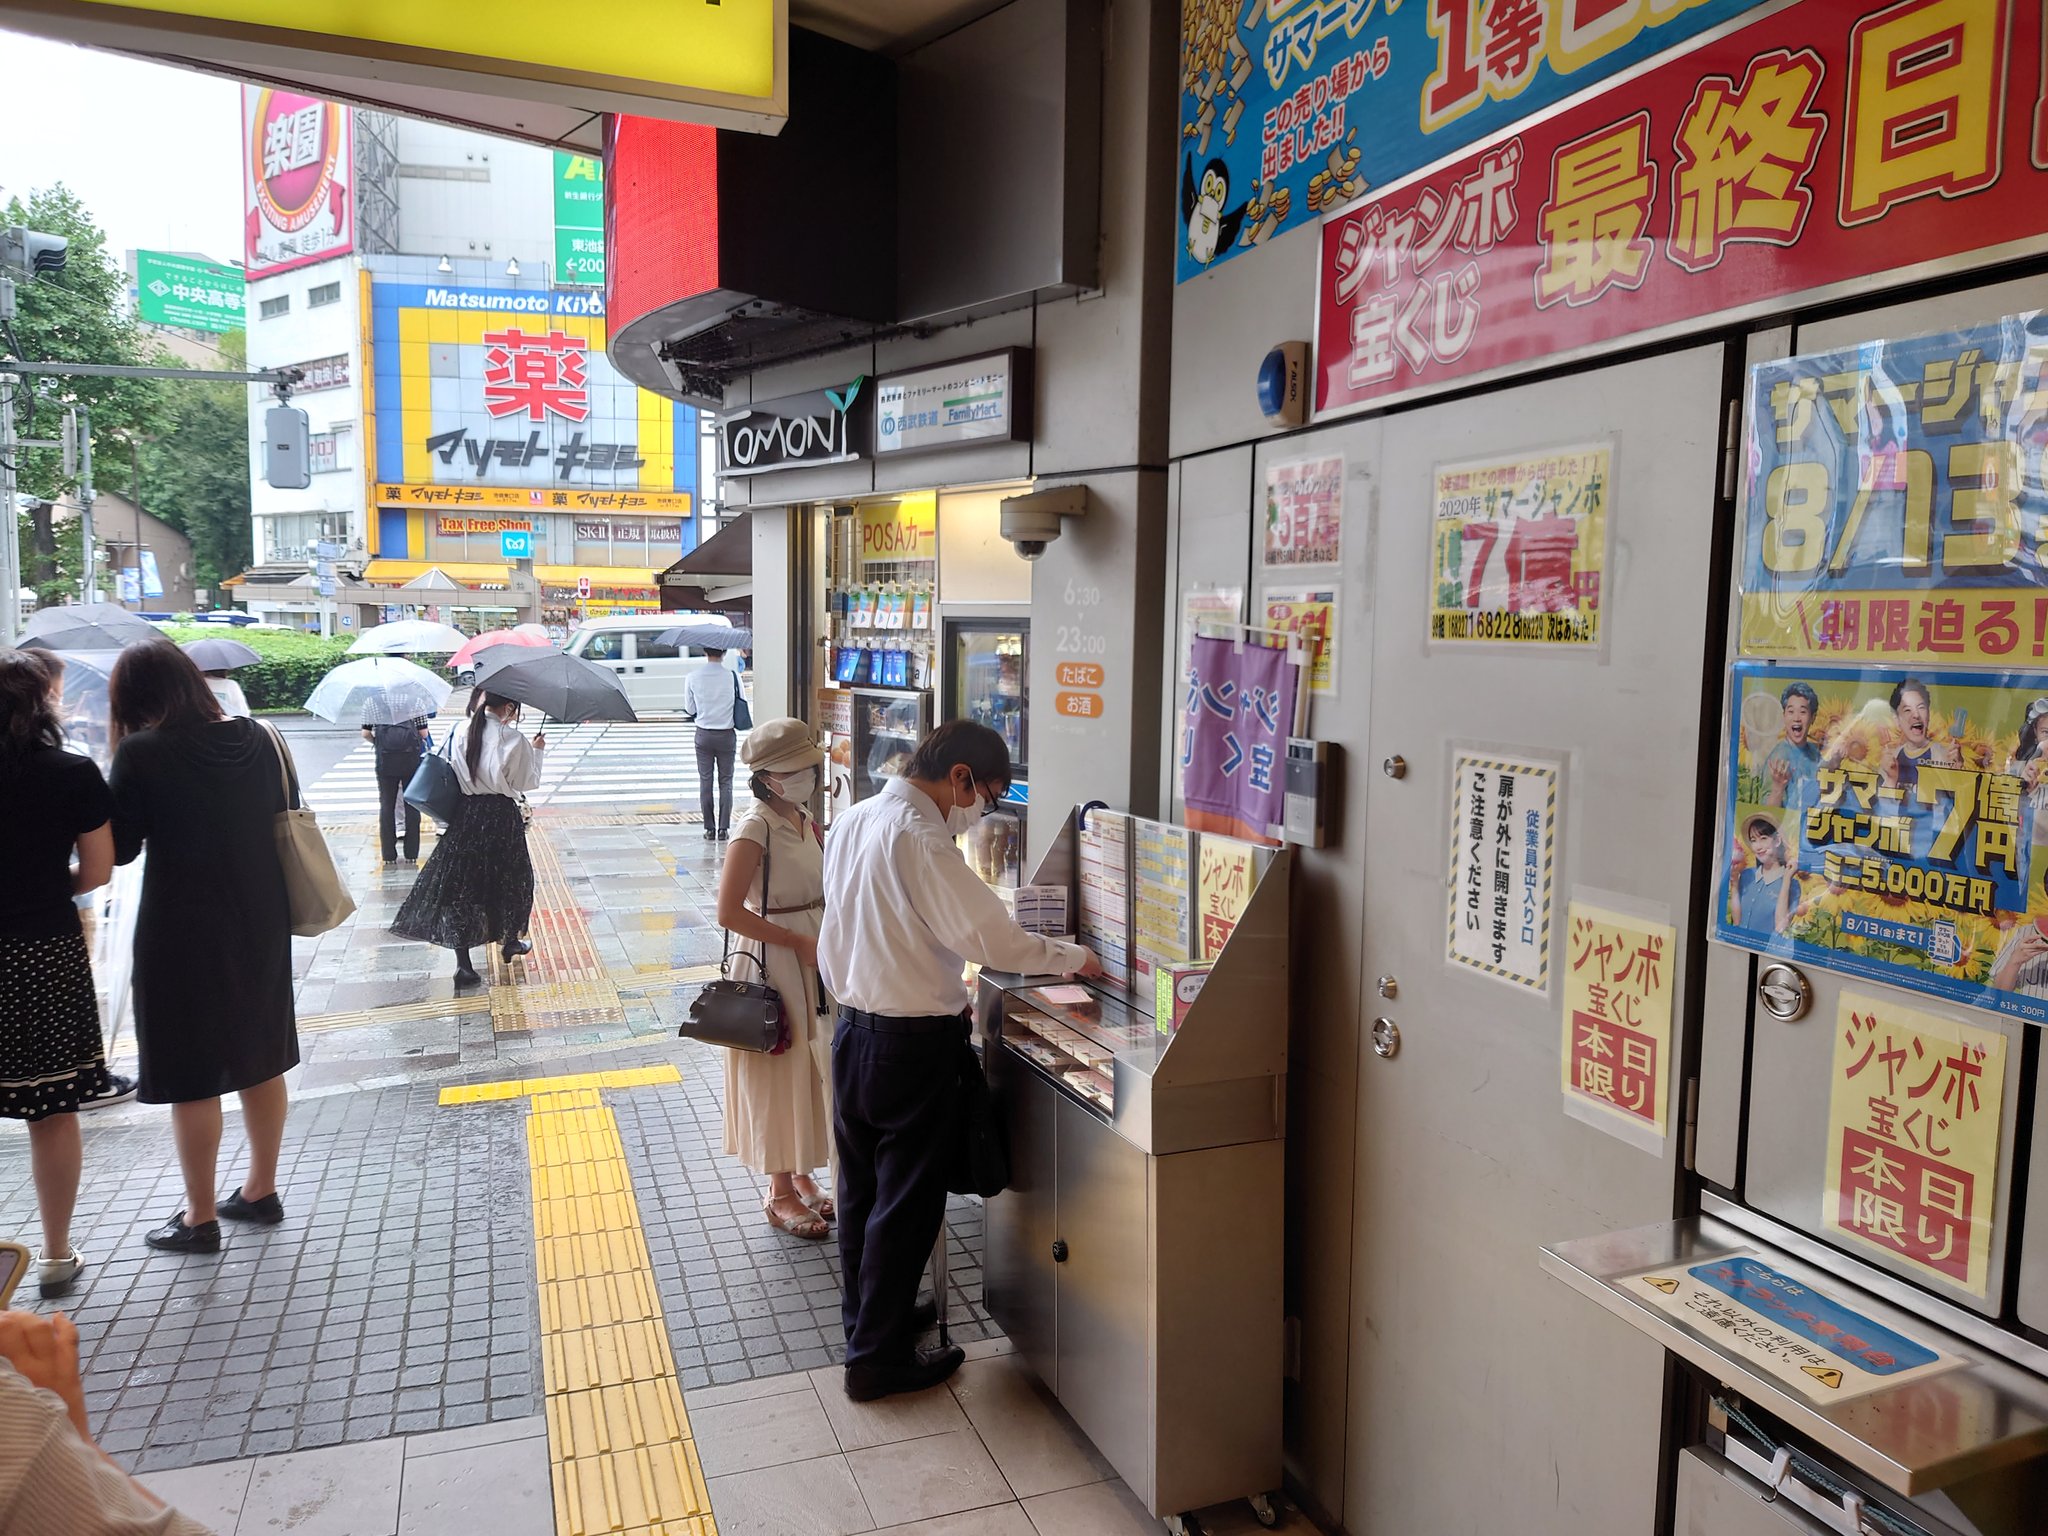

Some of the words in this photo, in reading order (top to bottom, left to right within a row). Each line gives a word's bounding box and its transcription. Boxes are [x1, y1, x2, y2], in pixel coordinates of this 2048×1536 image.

[1262, 38, 1392, 142] この売り場から
[264, 102, 325, 181] 楽園
[255, 180, 289, 231] EXCITING
[289, 154, 337, 231] AMUSEMENT
[1335, 138, 1522, 306] ジャンボ
[425, 288, 549, 312] Matsumoto
[1348, 264, 1482, 390] 宝くじ
[482, 328, 590, 423] 薬
[898, 410, 938, 432] 西武鉄道
[948, 401, 998, 422] FamilyMart
[426, 428, 646, 480] マツモトキヨシ
[385, 487, 402, 501] 薬
[410, 487, 485, 504] マツモトキヨシ
[552, 492, 568, 506] 薬
[576, 493, 648, 509] マツモトキヨシ
[440, 517, 465, 531] Tax
[466, 518, 496, 533] Free
[1064, 578, 1100, 606] 6:30
[1056, 625, 1106, 654] 23:00
[1062, 666, 1097, 684] たばこ
[1066, 696, 1092, 714] お酒
[1815, 768, 1905, 808] サマー
[1466, 771, 1487, 932] ご注意ください
[1805, 807, 1913, 854] ジャンボ
[1492, 776, 1514, 965] 扉が外に開きます
[1520, 809, 1540, 946] 従業員出入り口
[1572, 915, 1664, 997] ジャンボ
[1845, 917, 1925, 946] 8/13(金)まで!
[1587, 982, 1643, 1029] 宝くじ
[2021, 1004, 2046, 1018] 300円
[1577, 1023, 1652, 1078] 本日
[1845, 1011, 1987, 1120] ジャンボ
[1578, 1057, 1646, 1112] 限り
[1866, 1096, 1951, 1157] 宝くじ
[1851, 1146, 1965, 1220] 本日
[1853, 1186, 1954, 1261] 限り
[1744, 1265, 1805, 1297] こちらは
[1684, 1301, 1792, 1365] ご遠慮ください。
[1692, 1290, 1829, 1367] それ以外の利用は
